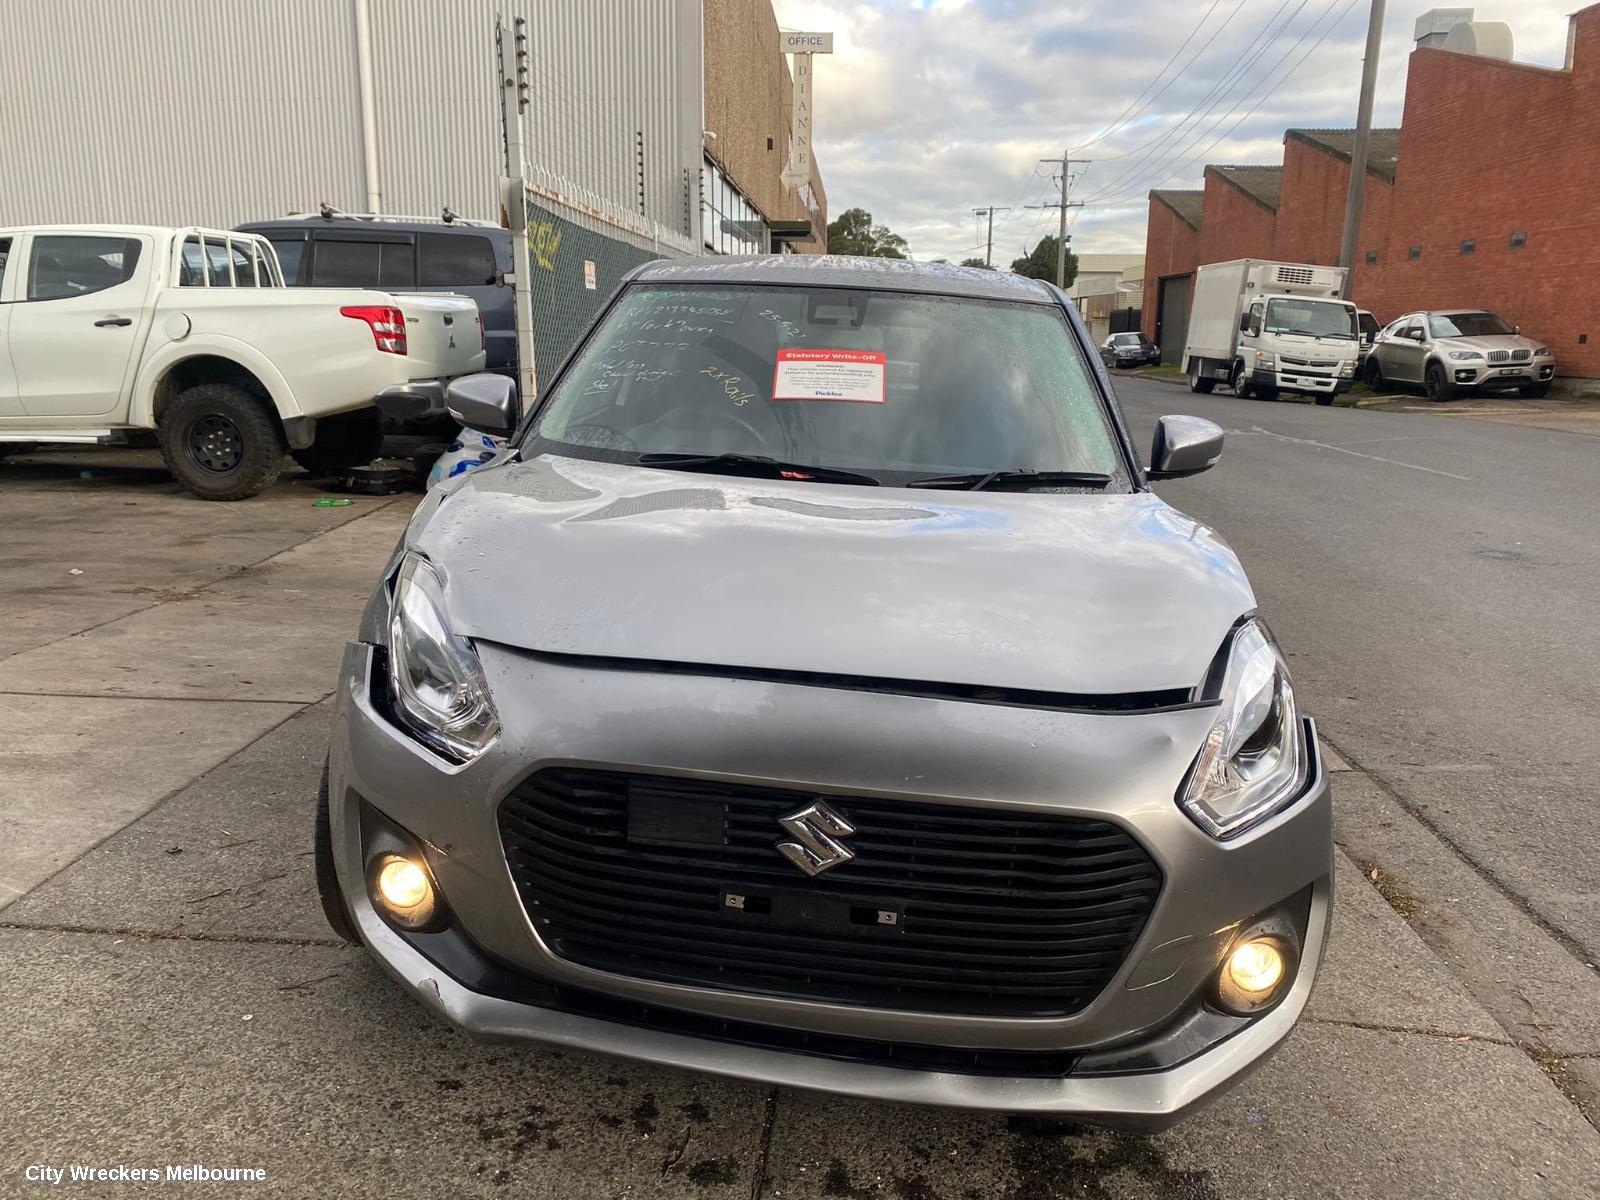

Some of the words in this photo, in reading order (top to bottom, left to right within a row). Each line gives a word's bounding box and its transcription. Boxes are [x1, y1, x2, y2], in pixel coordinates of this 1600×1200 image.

[788, 37, 823, 46] OFFICE
[798, 66, 807, 163] DIANNE
[786, 352, 830, 360] Statutory
